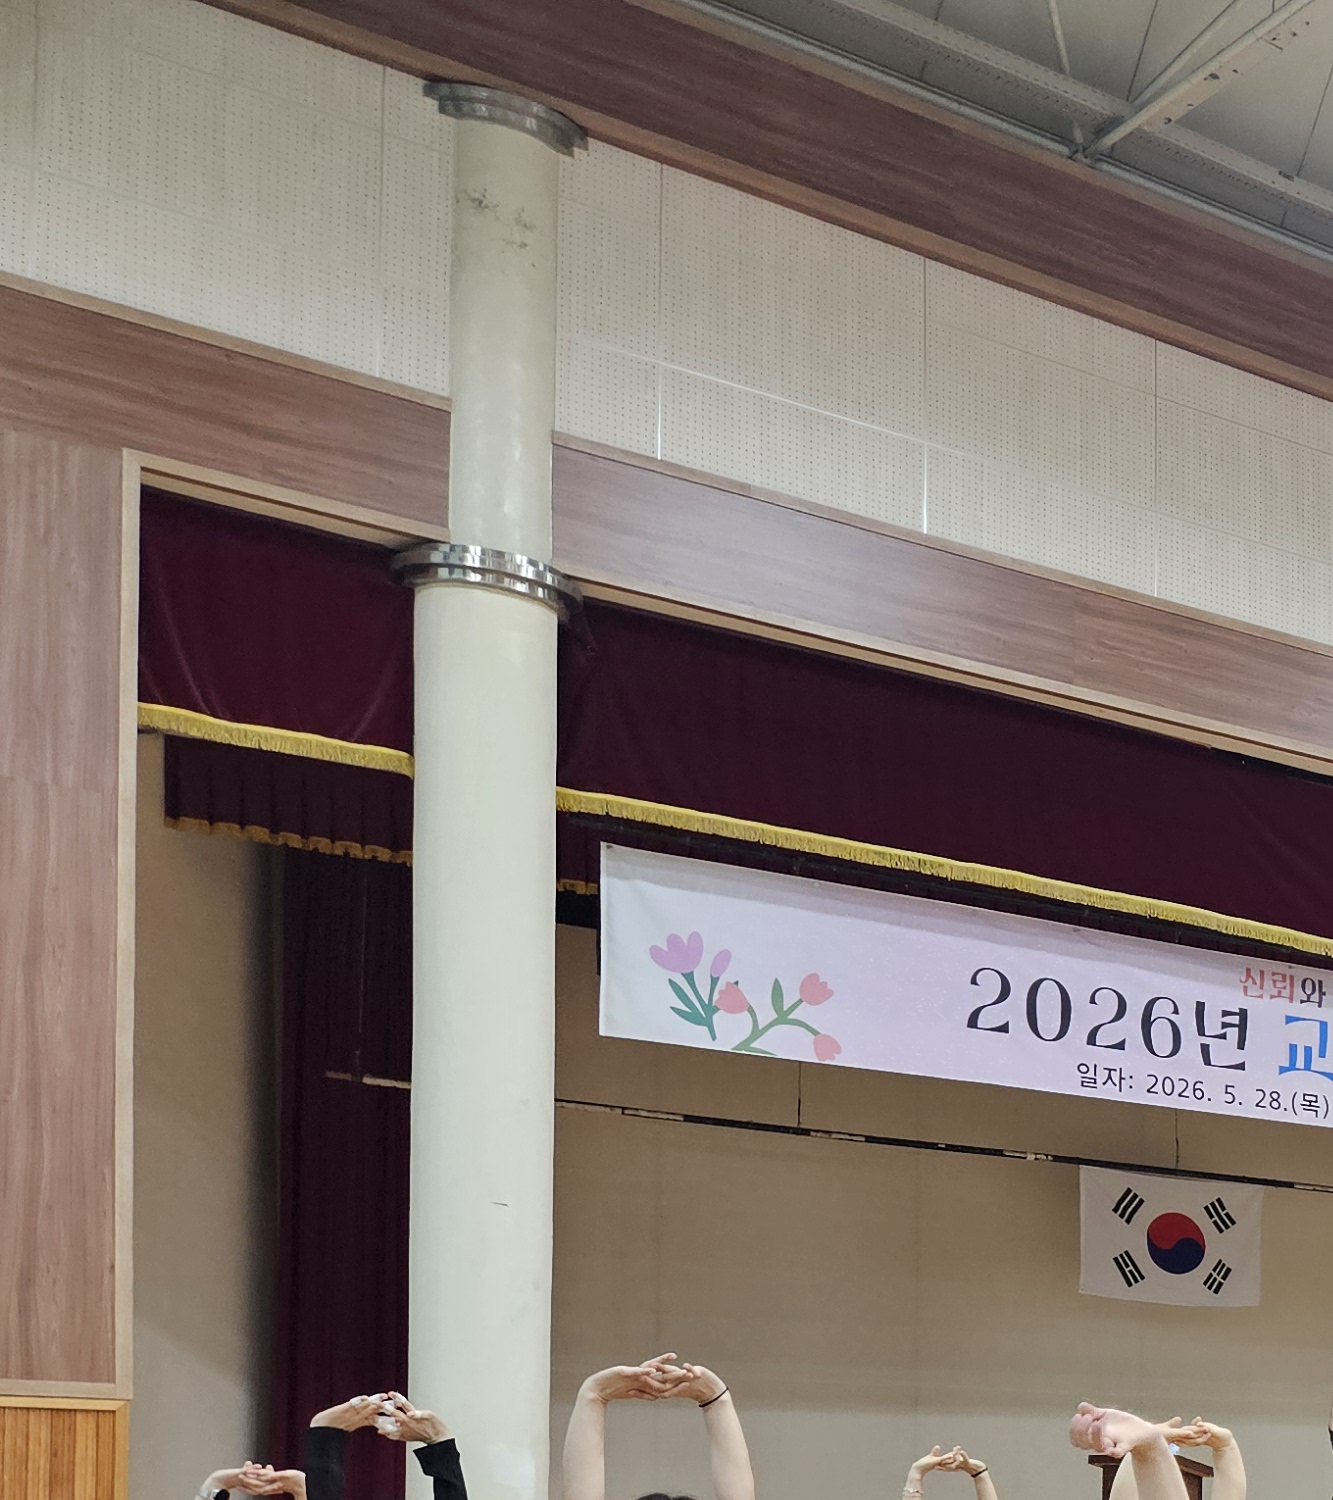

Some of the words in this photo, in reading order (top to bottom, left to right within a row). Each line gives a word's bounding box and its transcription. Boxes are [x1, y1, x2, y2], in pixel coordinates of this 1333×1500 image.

[1238, 966, 1327, 1010] 신뢰와
[967, 968, 1248, 1071] 2026년
[1077, 1063, 1133, 1092] 일자:
[1146, 1074, 1211, 1101] 2026.
[1224, 1084, 1242, 1105] 5.
[1255, 1089, 1329, 1119] 28.(목)
